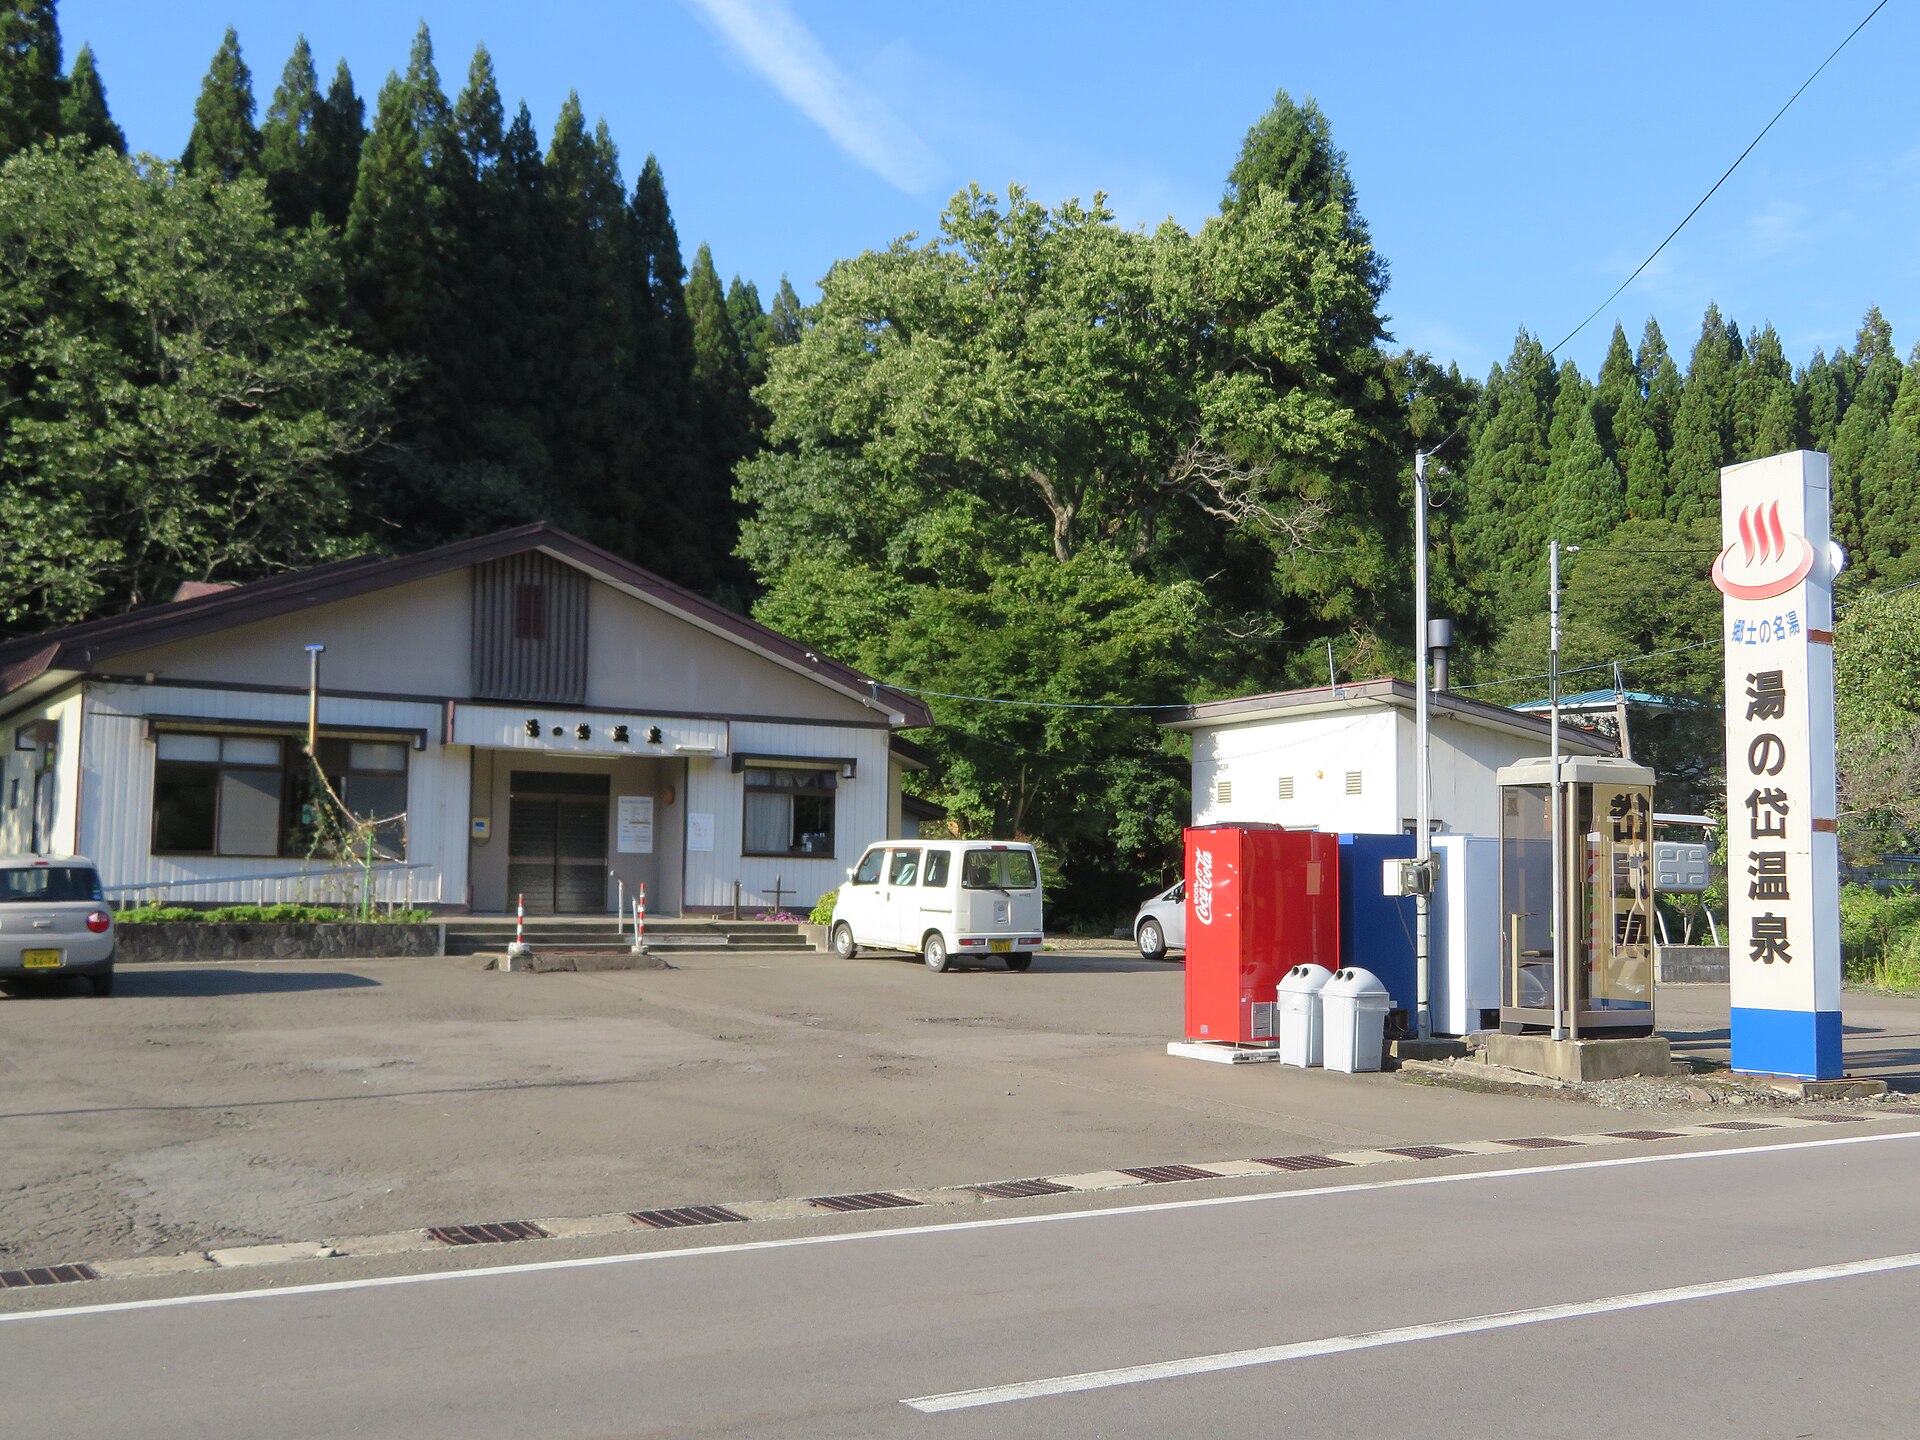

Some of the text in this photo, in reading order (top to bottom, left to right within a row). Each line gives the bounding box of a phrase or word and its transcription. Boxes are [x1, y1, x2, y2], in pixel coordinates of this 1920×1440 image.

[1732, 610, 1800, 645] 郷土の名湯
[1745, 669, 1793, 964] 湯の岱温泉
